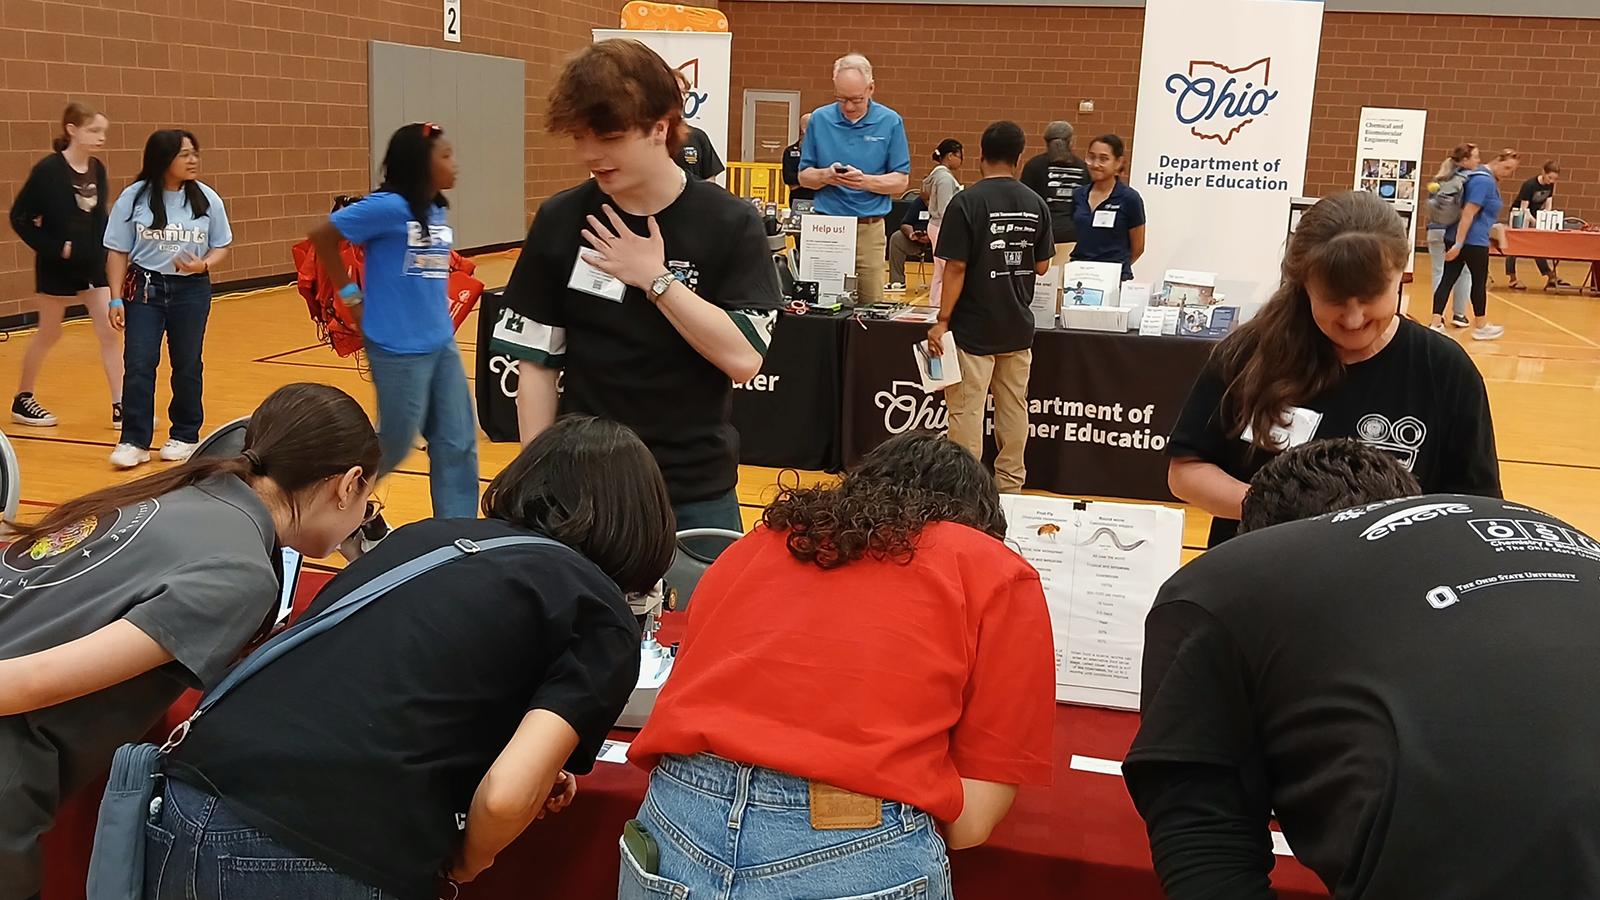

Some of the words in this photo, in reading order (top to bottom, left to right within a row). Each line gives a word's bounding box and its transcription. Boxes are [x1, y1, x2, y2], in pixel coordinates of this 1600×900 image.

[447, 7, 457, 35] 2
[1165, 73, 1279, 125] Ohio
[1364, 136, 1398, 144] Engineering
[1159, 155, 1259, 172] Department
[1263, 158, 1281, 172] of
[1147, 172, 1201, 189] Higher
[1206, 174, 1288, 191] Education
[136, 223, 207, 243] Peanuts
[812, 224, 832, 234] Help
[833, 225, 846, 234] us!
[874, 391, 951, 434] Ohi
[987, 393, 1123, 422] Dartment
[1128, 404, 1155, 424] of
[1064, 422, 1170, 451] Educatio
[1490, 539, 1543, 549] Chemistry
[1552, 547, 1576, 555] State
